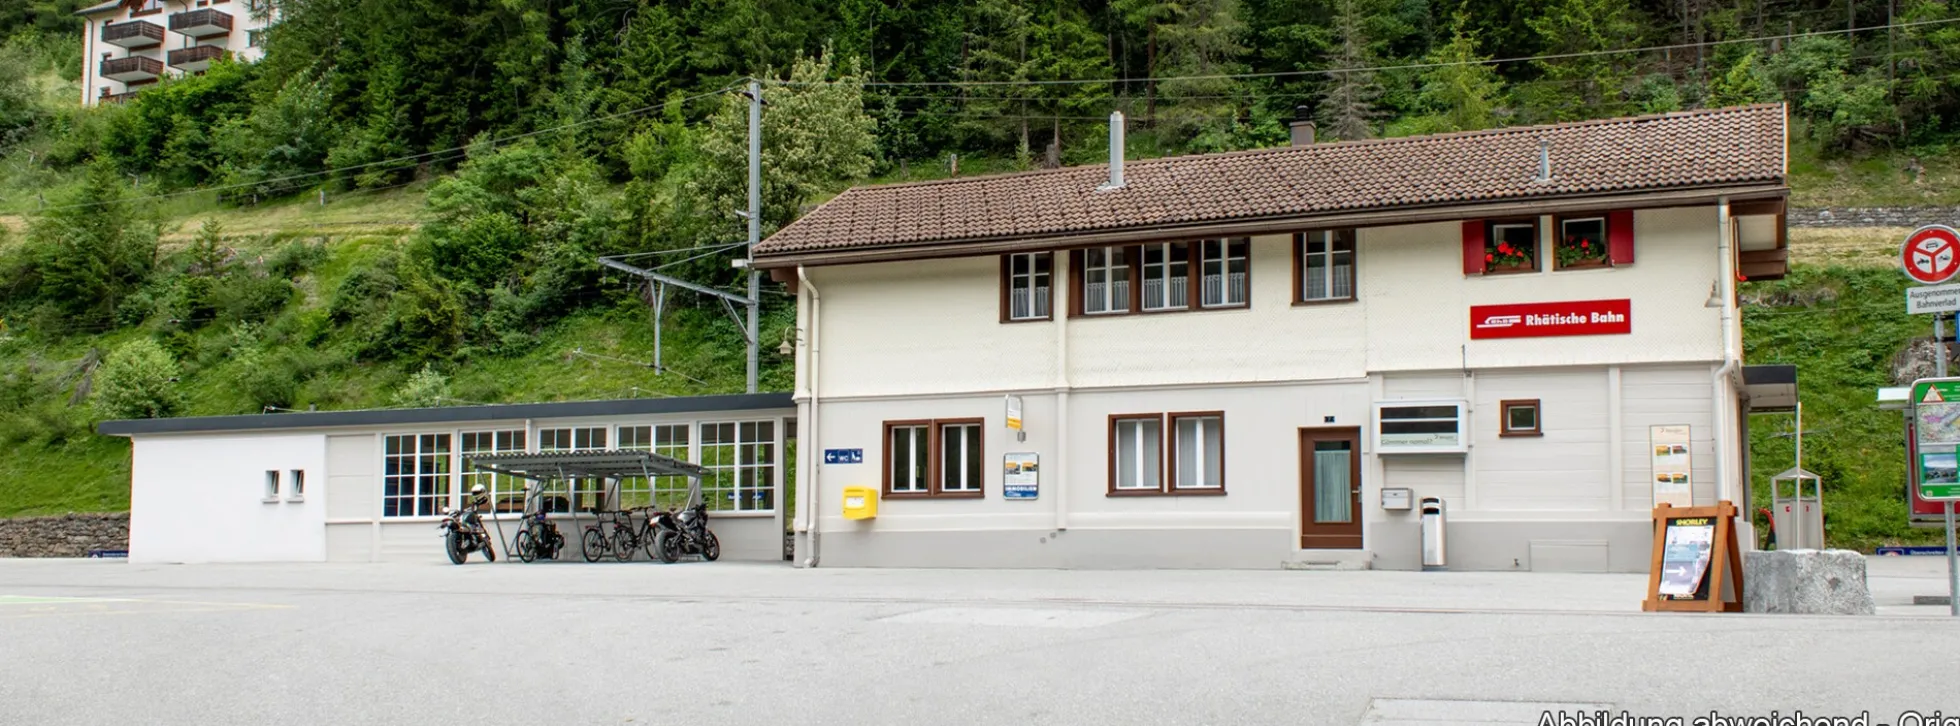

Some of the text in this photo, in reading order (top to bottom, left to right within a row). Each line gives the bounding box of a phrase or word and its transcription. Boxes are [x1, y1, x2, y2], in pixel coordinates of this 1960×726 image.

[1910, 289, 1960, 299] Ausgenomme
[1917, 298, 1956, 308] Bahnverlad
[1526, 313, 1587, 326] Rhätische
[1591, 311, 1624, 323] Bahn
